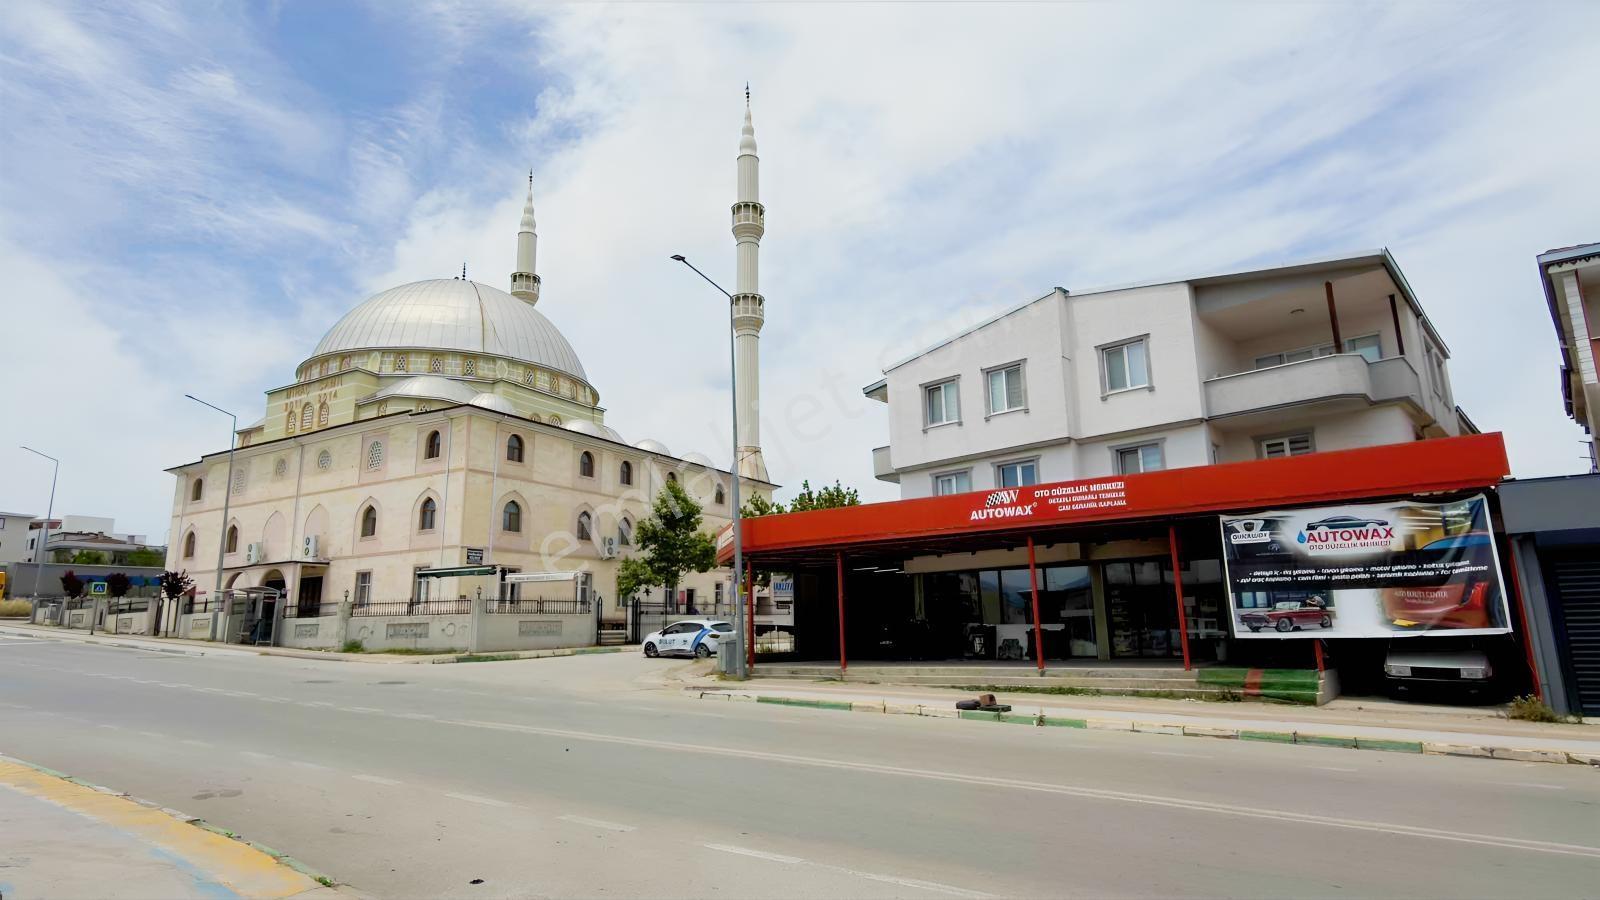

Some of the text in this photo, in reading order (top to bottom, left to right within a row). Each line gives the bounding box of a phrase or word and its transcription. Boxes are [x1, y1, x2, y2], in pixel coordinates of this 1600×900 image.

[1035, 489, 1049, 497] OTO
[970, 505, 1033, 520] AUTOWAX
[1307, 527, 1394, 543] AUTOWAX
